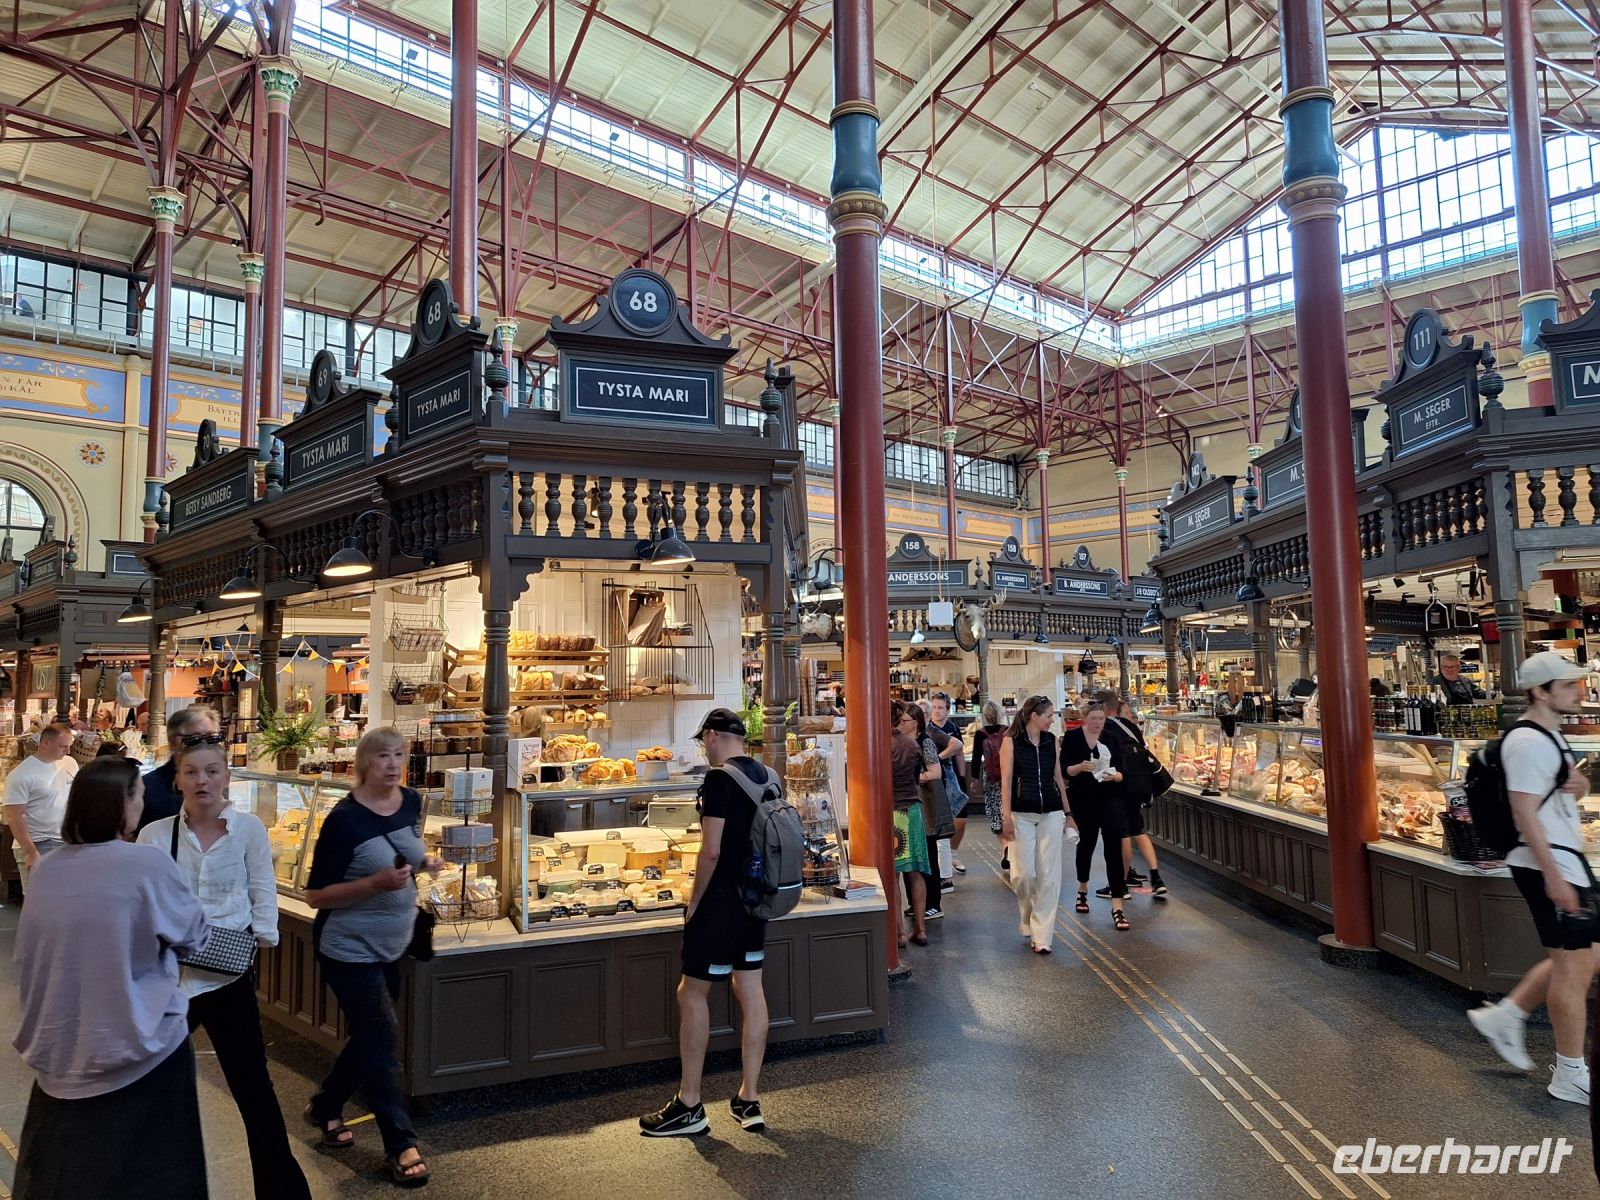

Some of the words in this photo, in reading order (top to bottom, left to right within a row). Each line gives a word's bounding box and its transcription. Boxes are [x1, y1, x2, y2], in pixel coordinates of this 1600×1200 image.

[427, 301, 441, 325] 68
[629, 290, 658, 313] 68
[1413, 327, 1431, 351] 111
[318, 368, 328, 388] 69
[416, 398, 438, 418] TYSTA
[440, 387, 461, 408] MARI
[598, 381, 644, 399] TYSTA
[649, 386, 689, 403] MARI
[1413, 410, 1424, 424] M.
[1425, 397, 1451, 419] SEGER
[302, 447, 325, 469] TYSTA
[326, 434, 350, 459] MARI
[1290, 466, 1300, 483] M.
[185, 498, 201, 516] BETSY
[200, 484, 232, 511] SANDBERG
[904, 541, 920, 550] 158
[1007, 543, 1017, 553] 158
[888, 572, 949, 582] ANDERSSONS
